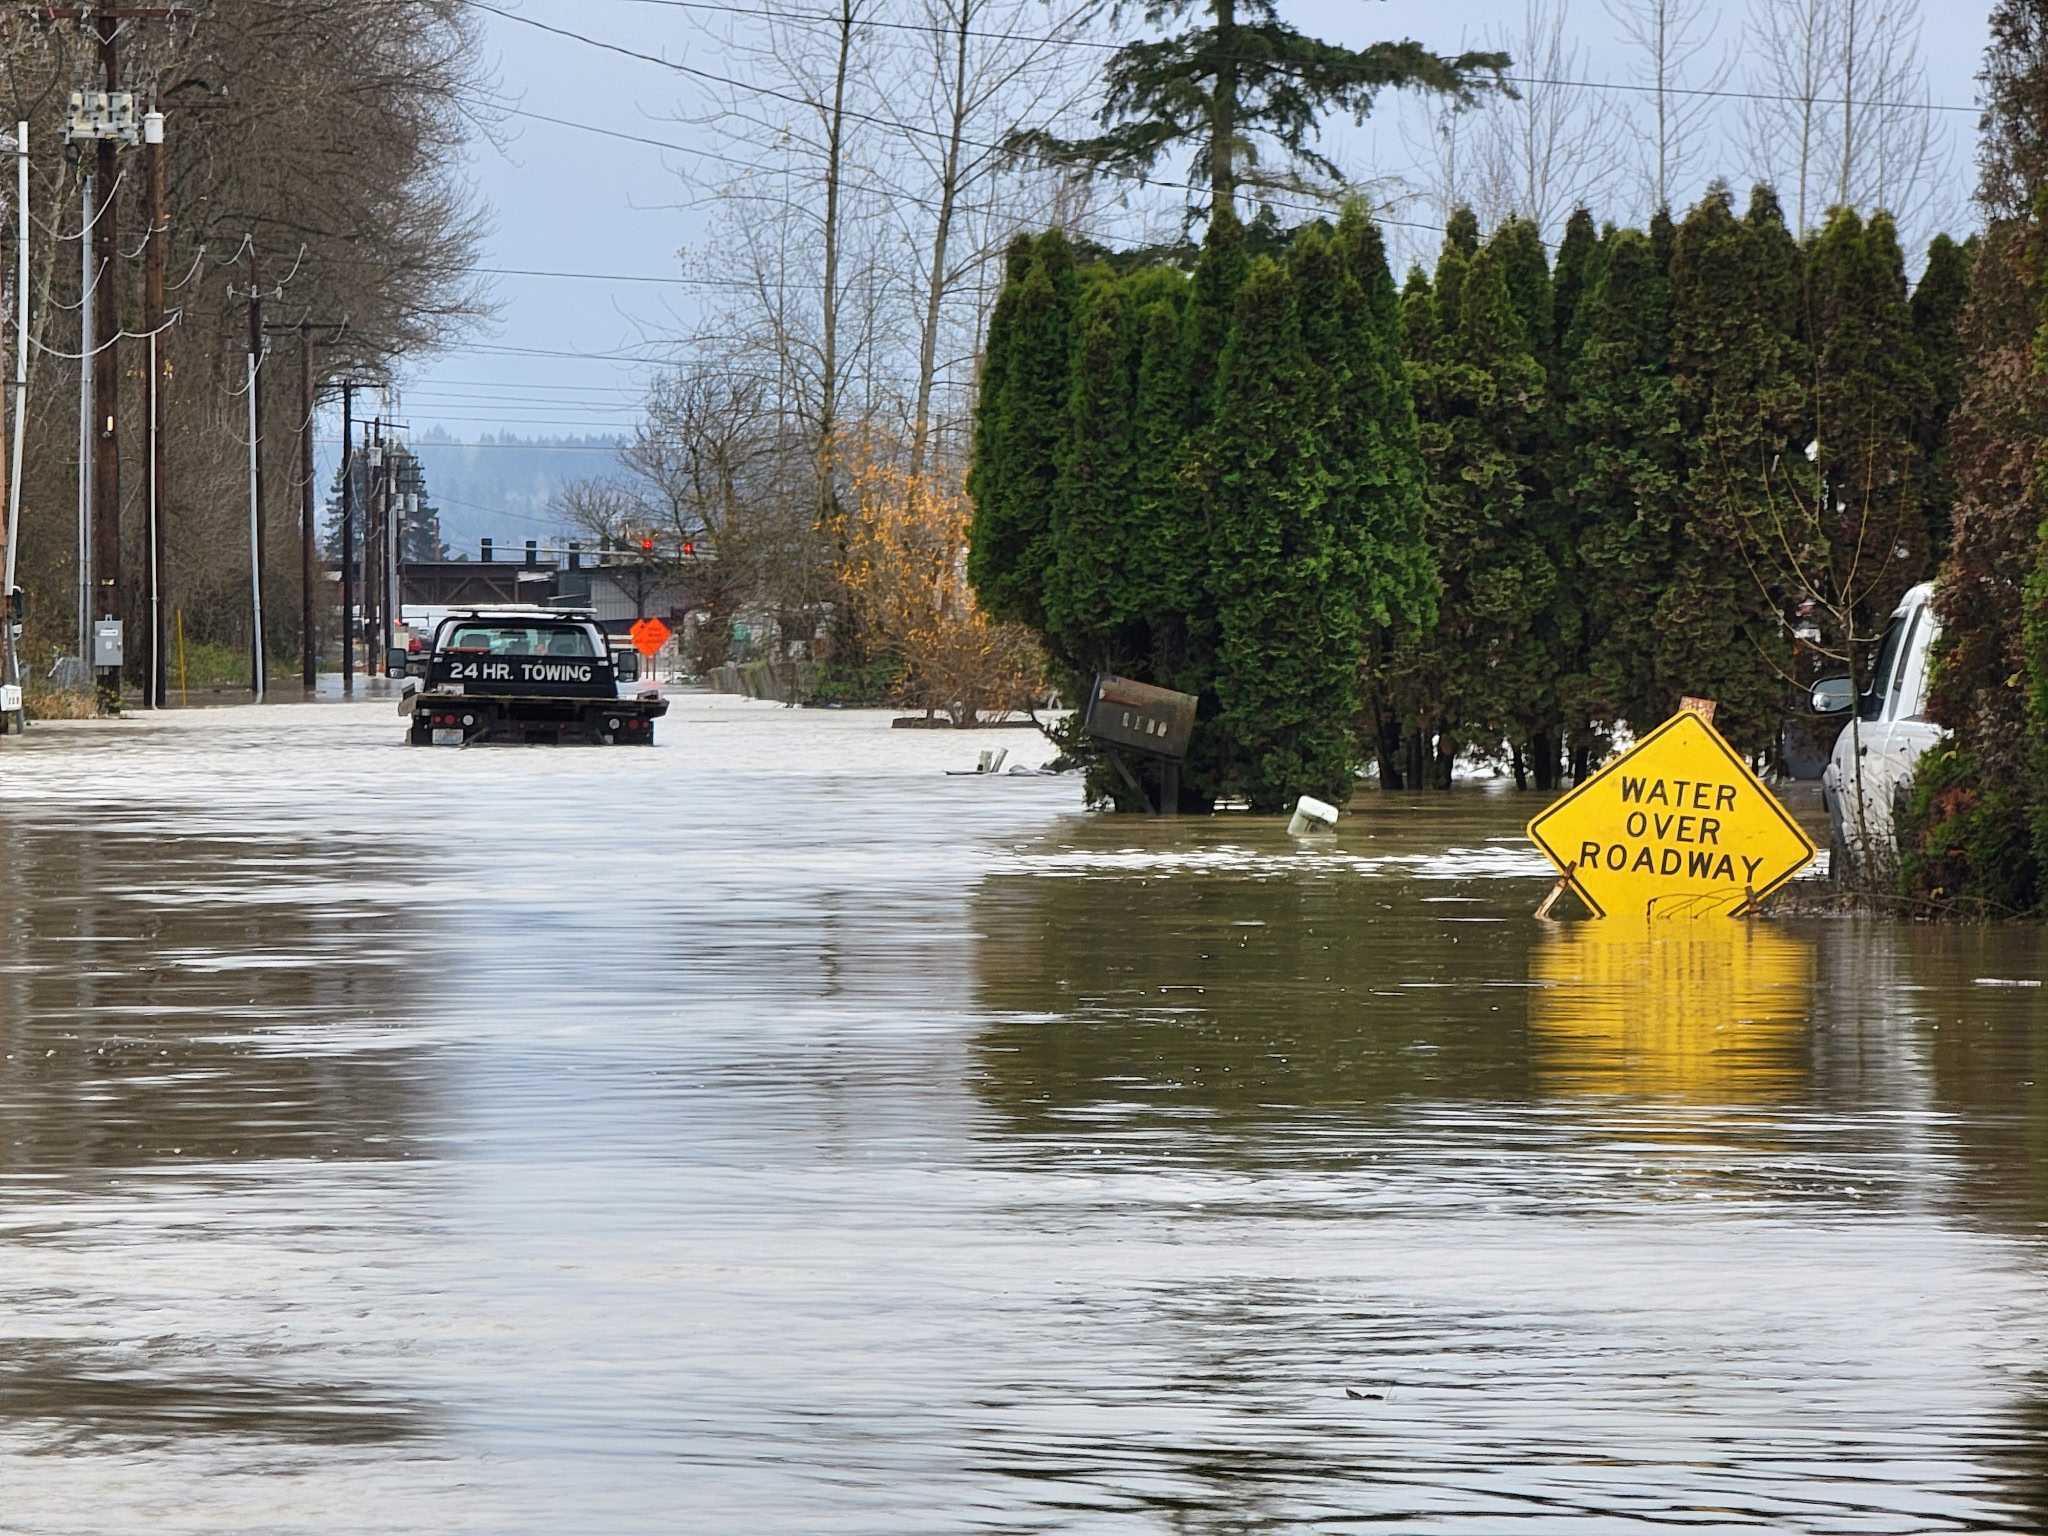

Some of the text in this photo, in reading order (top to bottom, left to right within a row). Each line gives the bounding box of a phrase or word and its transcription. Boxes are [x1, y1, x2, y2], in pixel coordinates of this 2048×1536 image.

[450, 662, 592, 683] 24 HR. TOWING
[1622, 776, 1737, 812] WATER
[1626, 811, 1721, 845] OVER
[1579, 841, 1764, 883] ROADWAY
